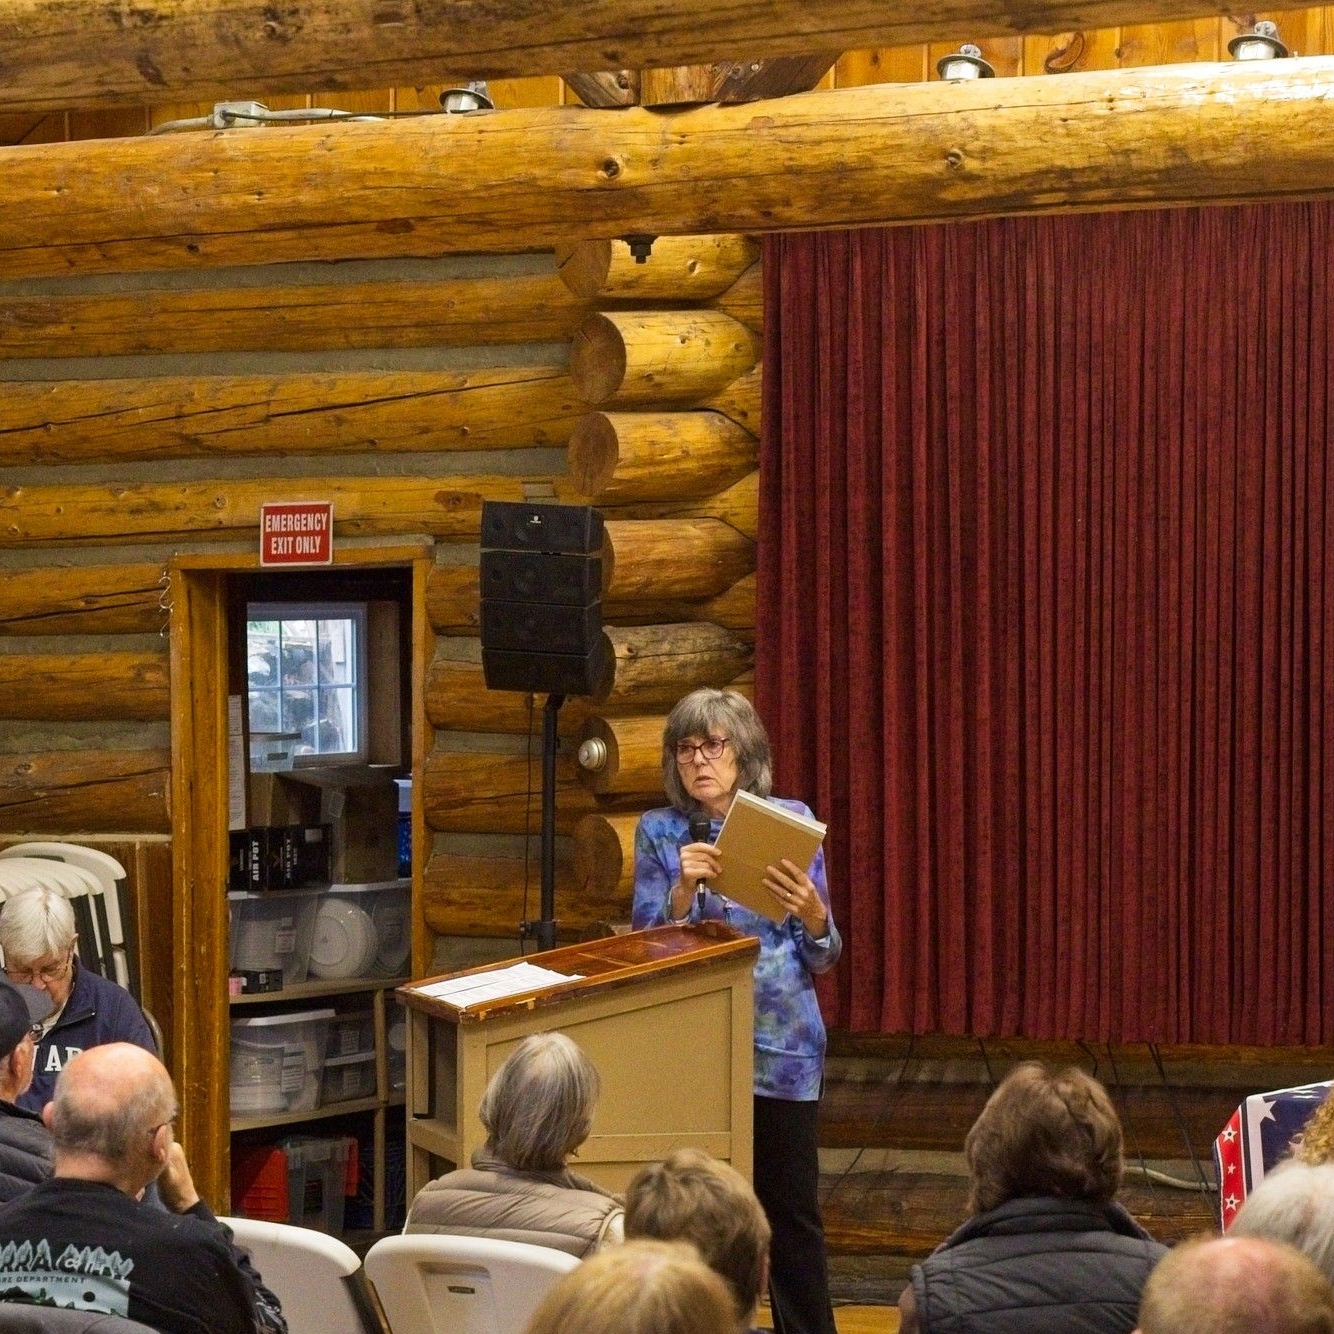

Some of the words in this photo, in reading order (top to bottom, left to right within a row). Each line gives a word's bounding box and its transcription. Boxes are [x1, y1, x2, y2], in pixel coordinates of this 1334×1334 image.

[265, 513, 328, 532] EMERGENCY
[271, 537, 293, 555] EXIT
[296, 535, 321, 554] ONLY
[252, 840, 260, 861] POT
[252, 862, 260, 881] AIR
[16, 1275, 86, 1285] DEPARTMENT
